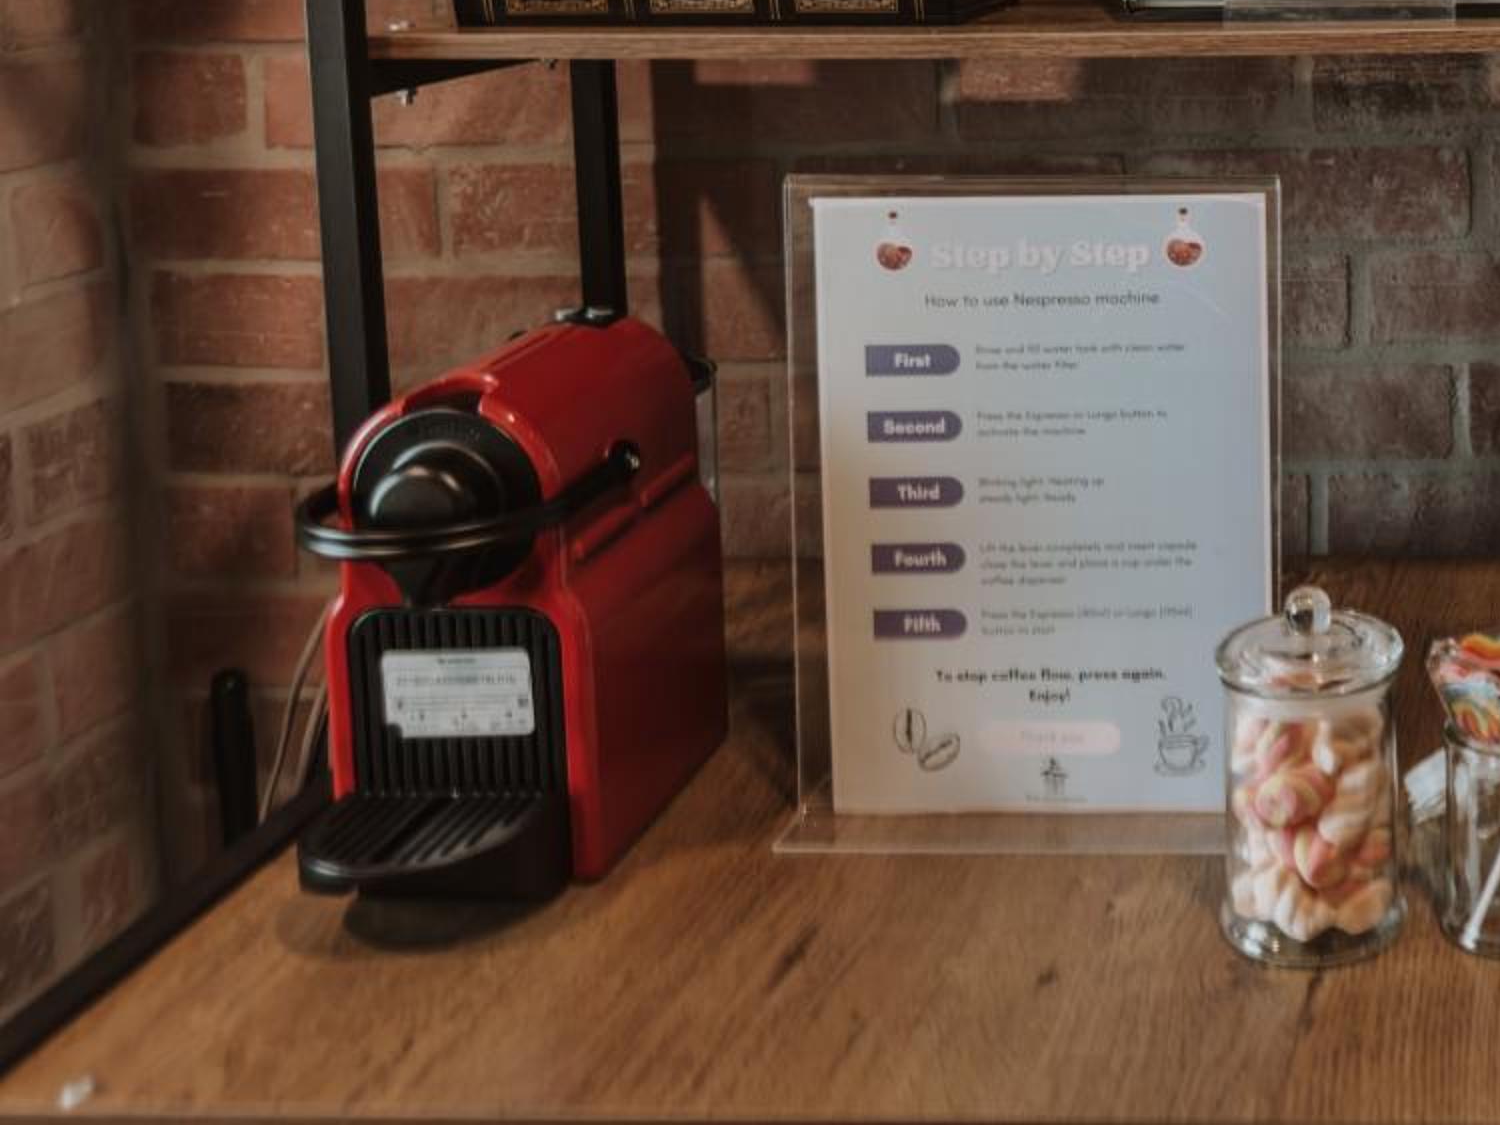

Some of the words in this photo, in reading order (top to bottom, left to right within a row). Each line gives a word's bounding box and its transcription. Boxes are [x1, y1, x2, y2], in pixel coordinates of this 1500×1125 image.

[930, 242, 1010, 273] Step
[1019, 240, 1058, 274] by
[1071, 239, 1150, 273] Step
[925, 293, 959, 308] How
[963, 293, 978, 307] to
[983, 295, 1009, 307] use
[1014, 292, 1090, 309] Nespresso
[1095, 290, 1161, 306] machine
[895, 352, 931, 368] First
[883, 416, 945, 435] Second
[897, 483, 941, 502] Third
[894, 548, 948, 568] Fourth
[903, 614, 942, 634] Fifth
[936, 670, 953, 682] To
[957, 669, 987, 684] stop
[991, 668, 1037, 682] coffee
[1078, 669, 1118, 683] press
[1028, 688, 1071, 706] Enjoy!
